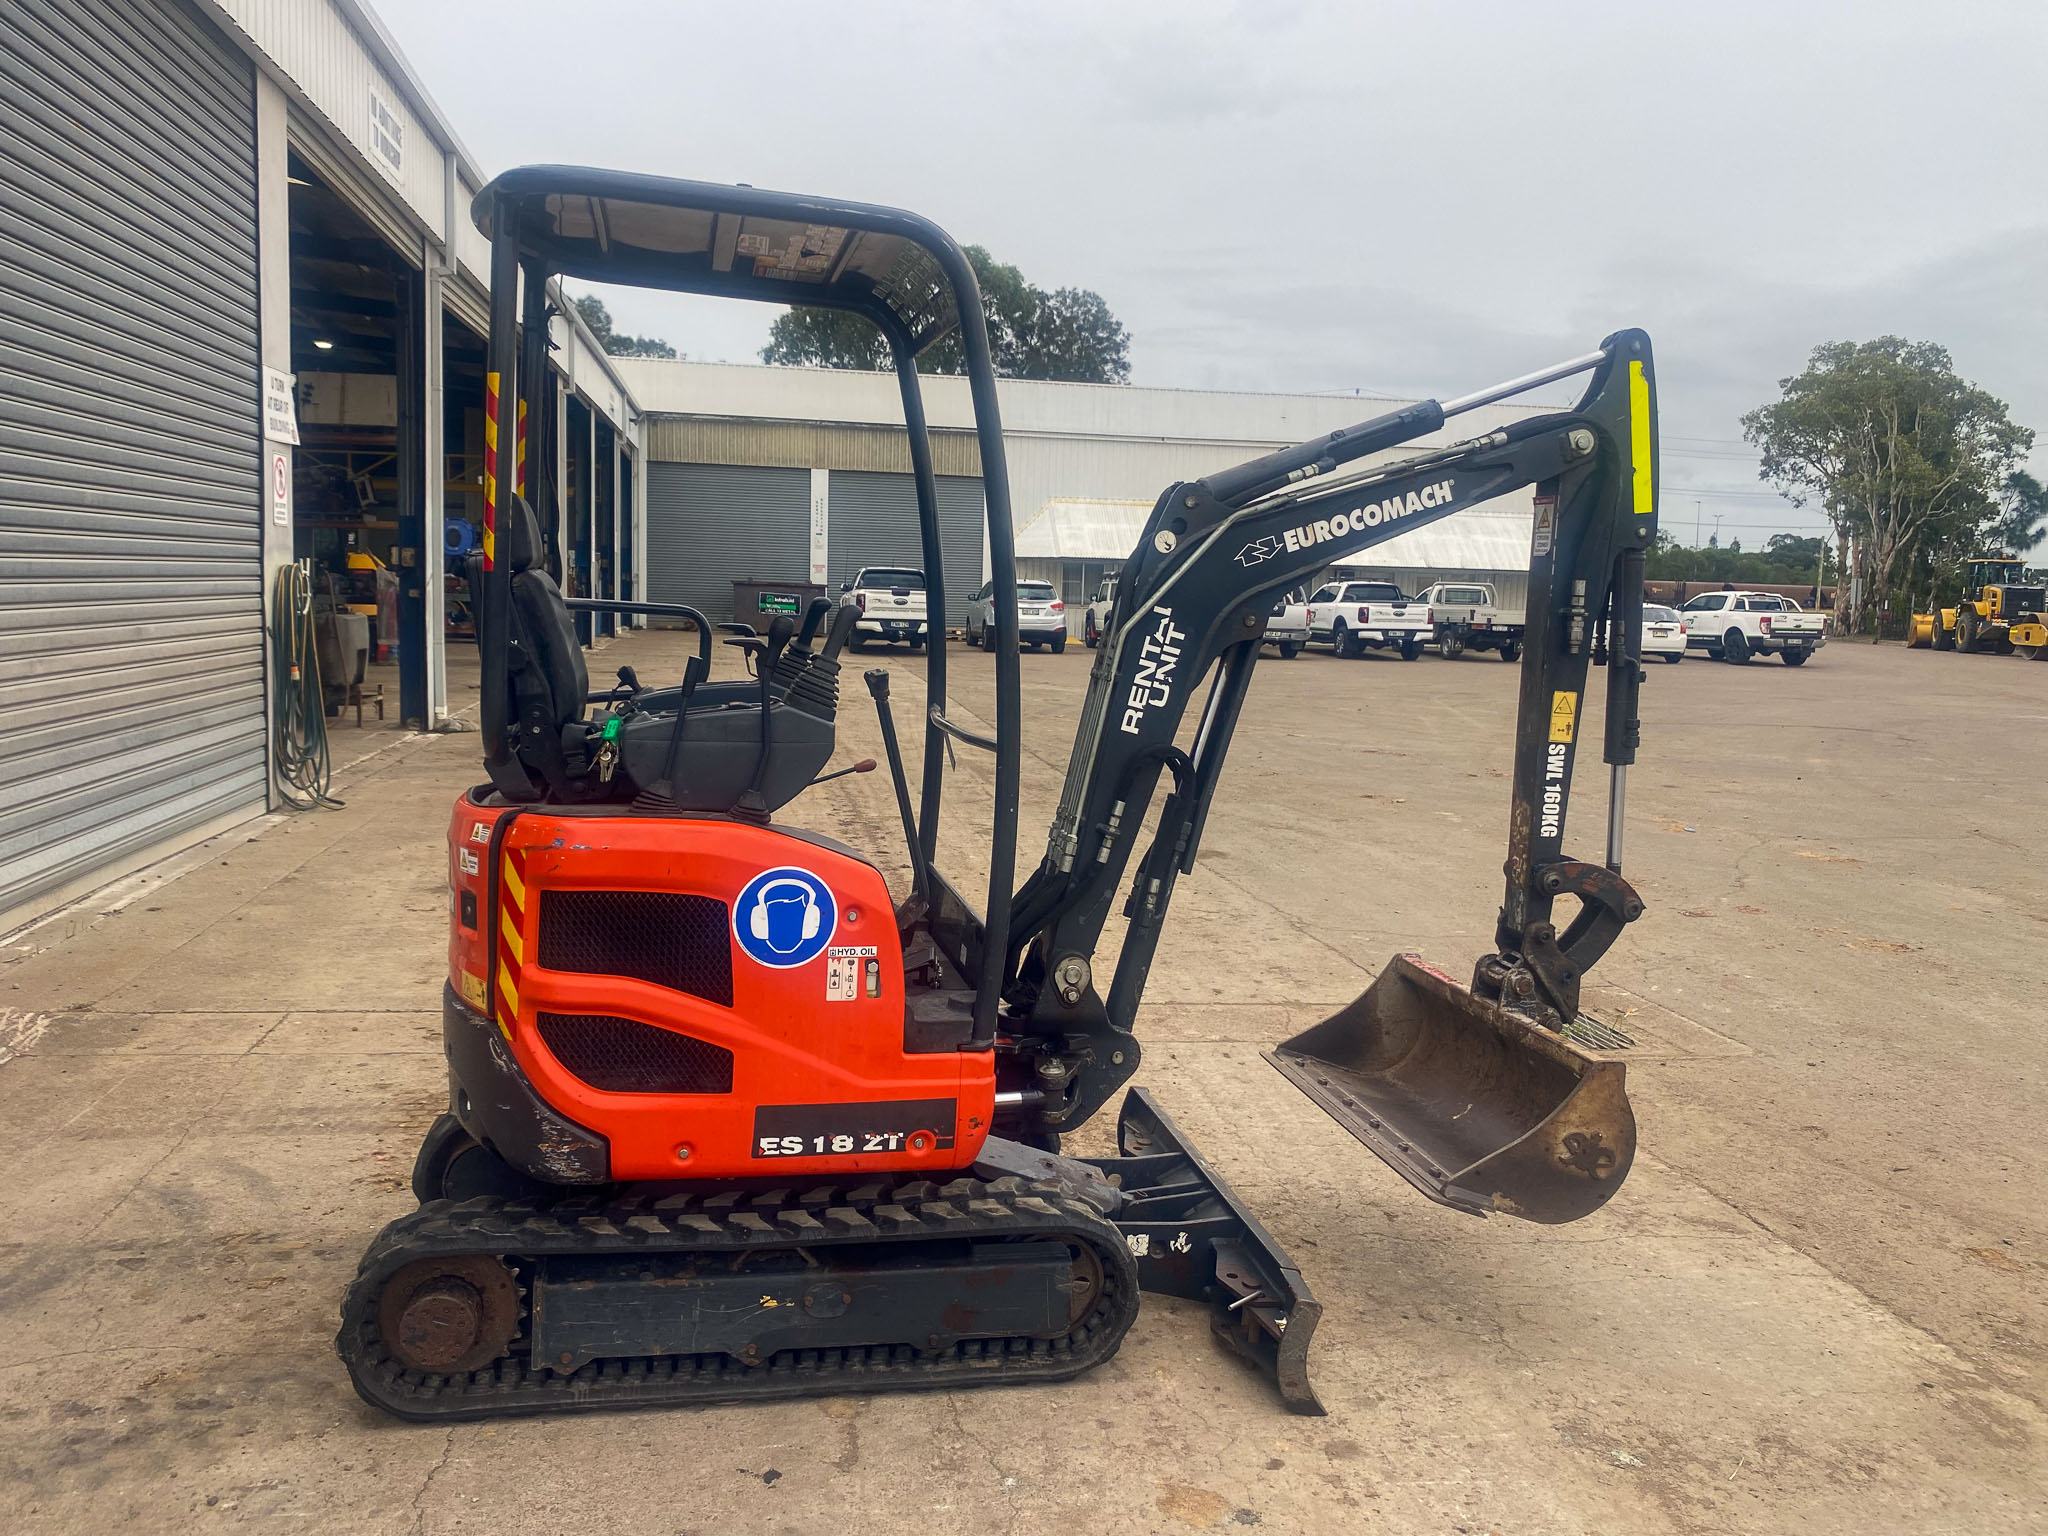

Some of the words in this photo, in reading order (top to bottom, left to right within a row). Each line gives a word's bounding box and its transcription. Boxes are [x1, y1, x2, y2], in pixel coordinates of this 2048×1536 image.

[1282, 481, 1454, 553] EUROCOMACH
[1148, 621, 1186, 708] UNIT
[1545, 743, 1566, 780] SWL
[1540, 783, 1562, 838] 160KG
[837, 948, 859, 956] HYD.
[860, 947, 876, 956] OIL
[759, 1136, 803, 1156] ES
